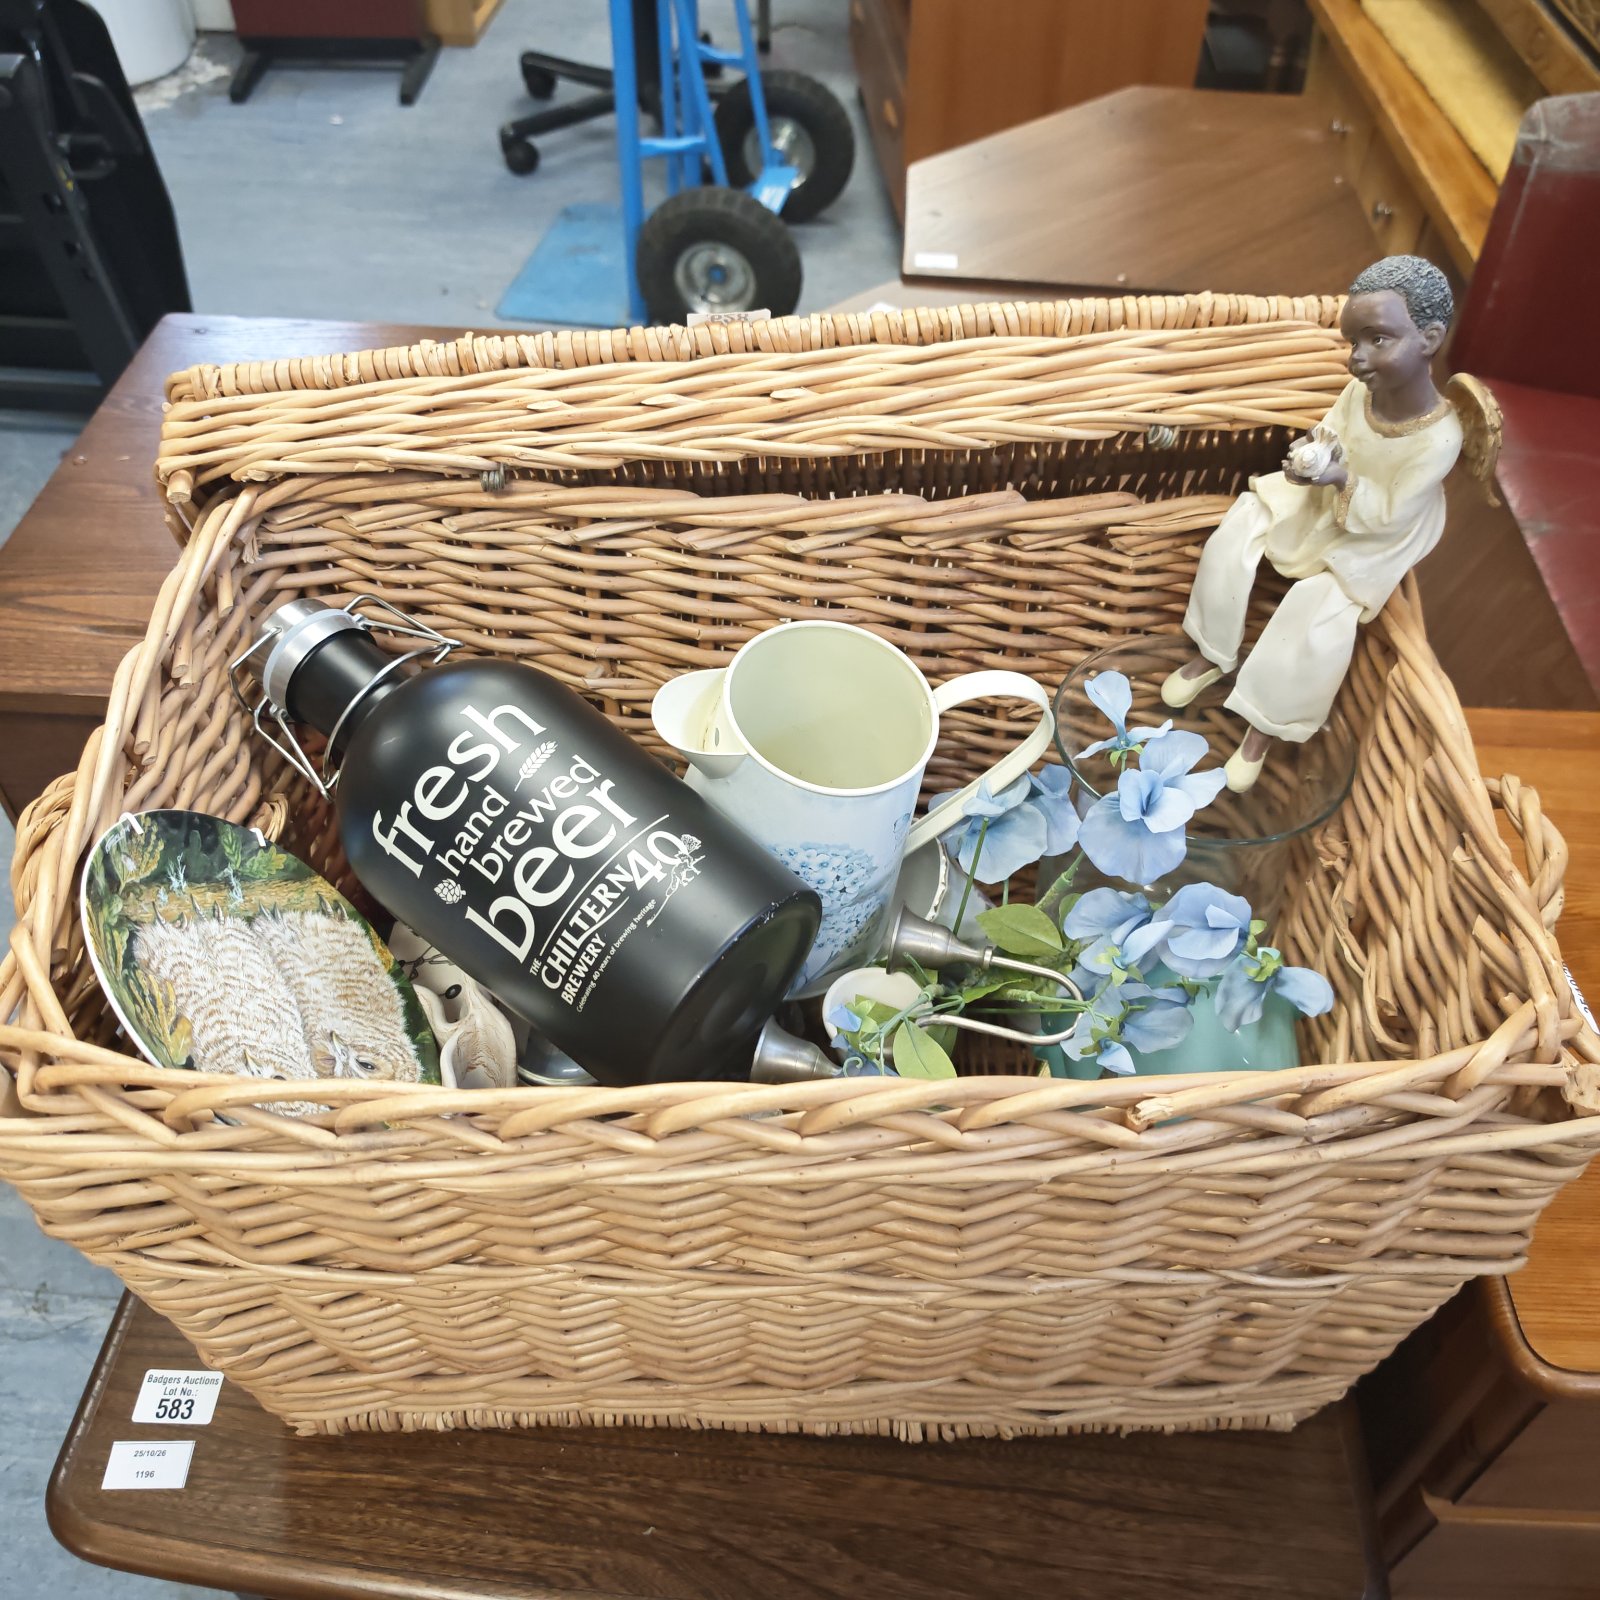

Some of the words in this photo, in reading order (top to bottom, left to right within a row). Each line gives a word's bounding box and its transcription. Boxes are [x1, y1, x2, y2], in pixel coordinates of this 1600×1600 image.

[372, 704, 547, 879] fresh
[435, 785, 510, 877] hand
[468, 754, 601, 885] brewed
[464, 778, 638, 965] beer
[529, 957, 542, 977] THE
[560, 932, 607, 1006] BREWERY
[576, 980, 597, 1013] Celebrating
[592, 970, 601, 981] 40
[598, 955, 612, 972] years
[609, 945, 617, 956] of
[613, 921, 638, 949] brewing
[632, 898, 657, 924] heritage
[147, 1374, 181, 1386] Badgers
[183, 1375, 220, 1386] Auctions
[163, 1386, 178, 1396] Lot
[155, 1398, 195, 1420] 583
[133, 1449, 167, 1458] 25/10/26
[135, 1470, 156, 1479] 1196
